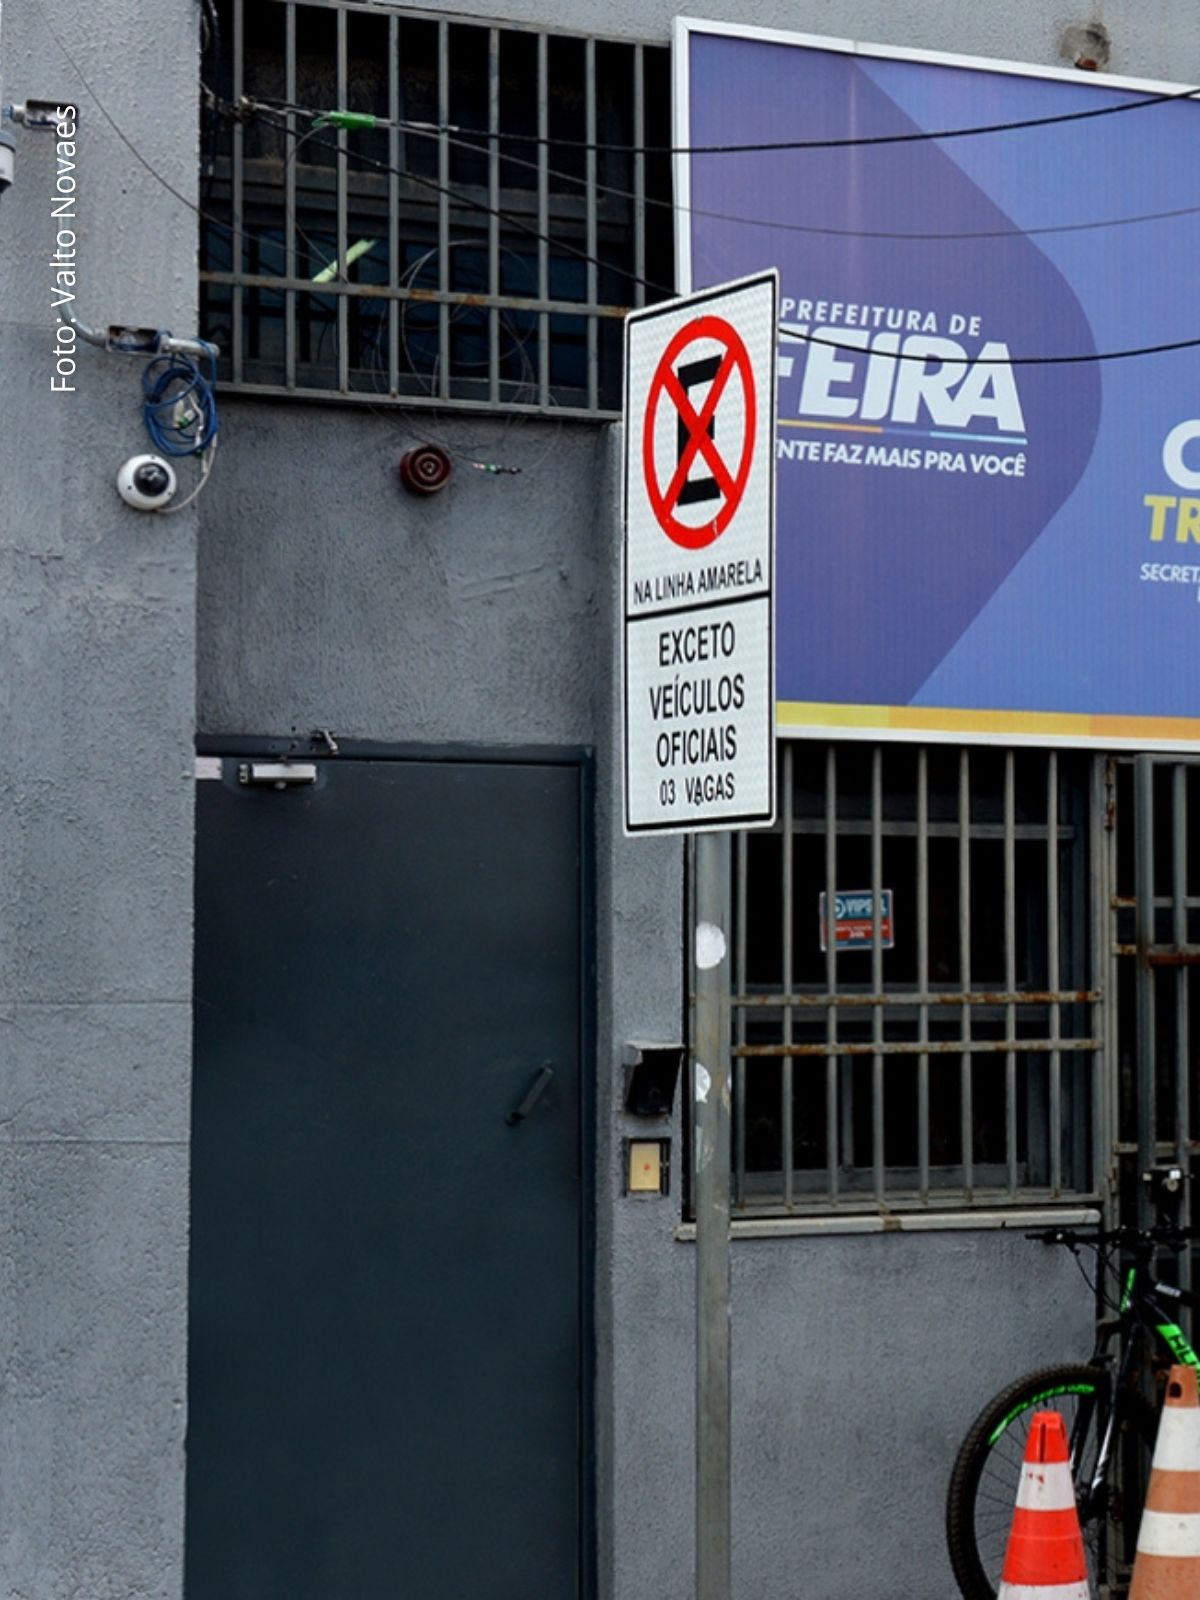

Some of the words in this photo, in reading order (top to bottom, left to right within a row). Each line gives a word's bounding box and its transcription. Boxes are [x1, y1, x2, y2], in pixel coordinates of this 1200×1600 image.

[780, 297, 938, 333] PREFEITURA
[949, 313, 982, 337] DE
[777, 438, 822, 462] NTE
[823, 443, 864, 464] FAZ
[865, 446, 922, 469] MAIS
[924, 451, 967, 473] PRA
[969, 452, 1026, 477] VOCÊ
[634, 580, 652, 604] NA
[655, 572, 694, 601] LINHA
[697, 558, 763, 593] AMARELA
[659, 621, 736, 667] EXCETO
[649, 673, 745, 721] VEÍCULOS
[656, 724, 737, 768] OFICIAIS
[659, 779, 676, 806] 03
[685, 772, 735, 805] VAGAS
